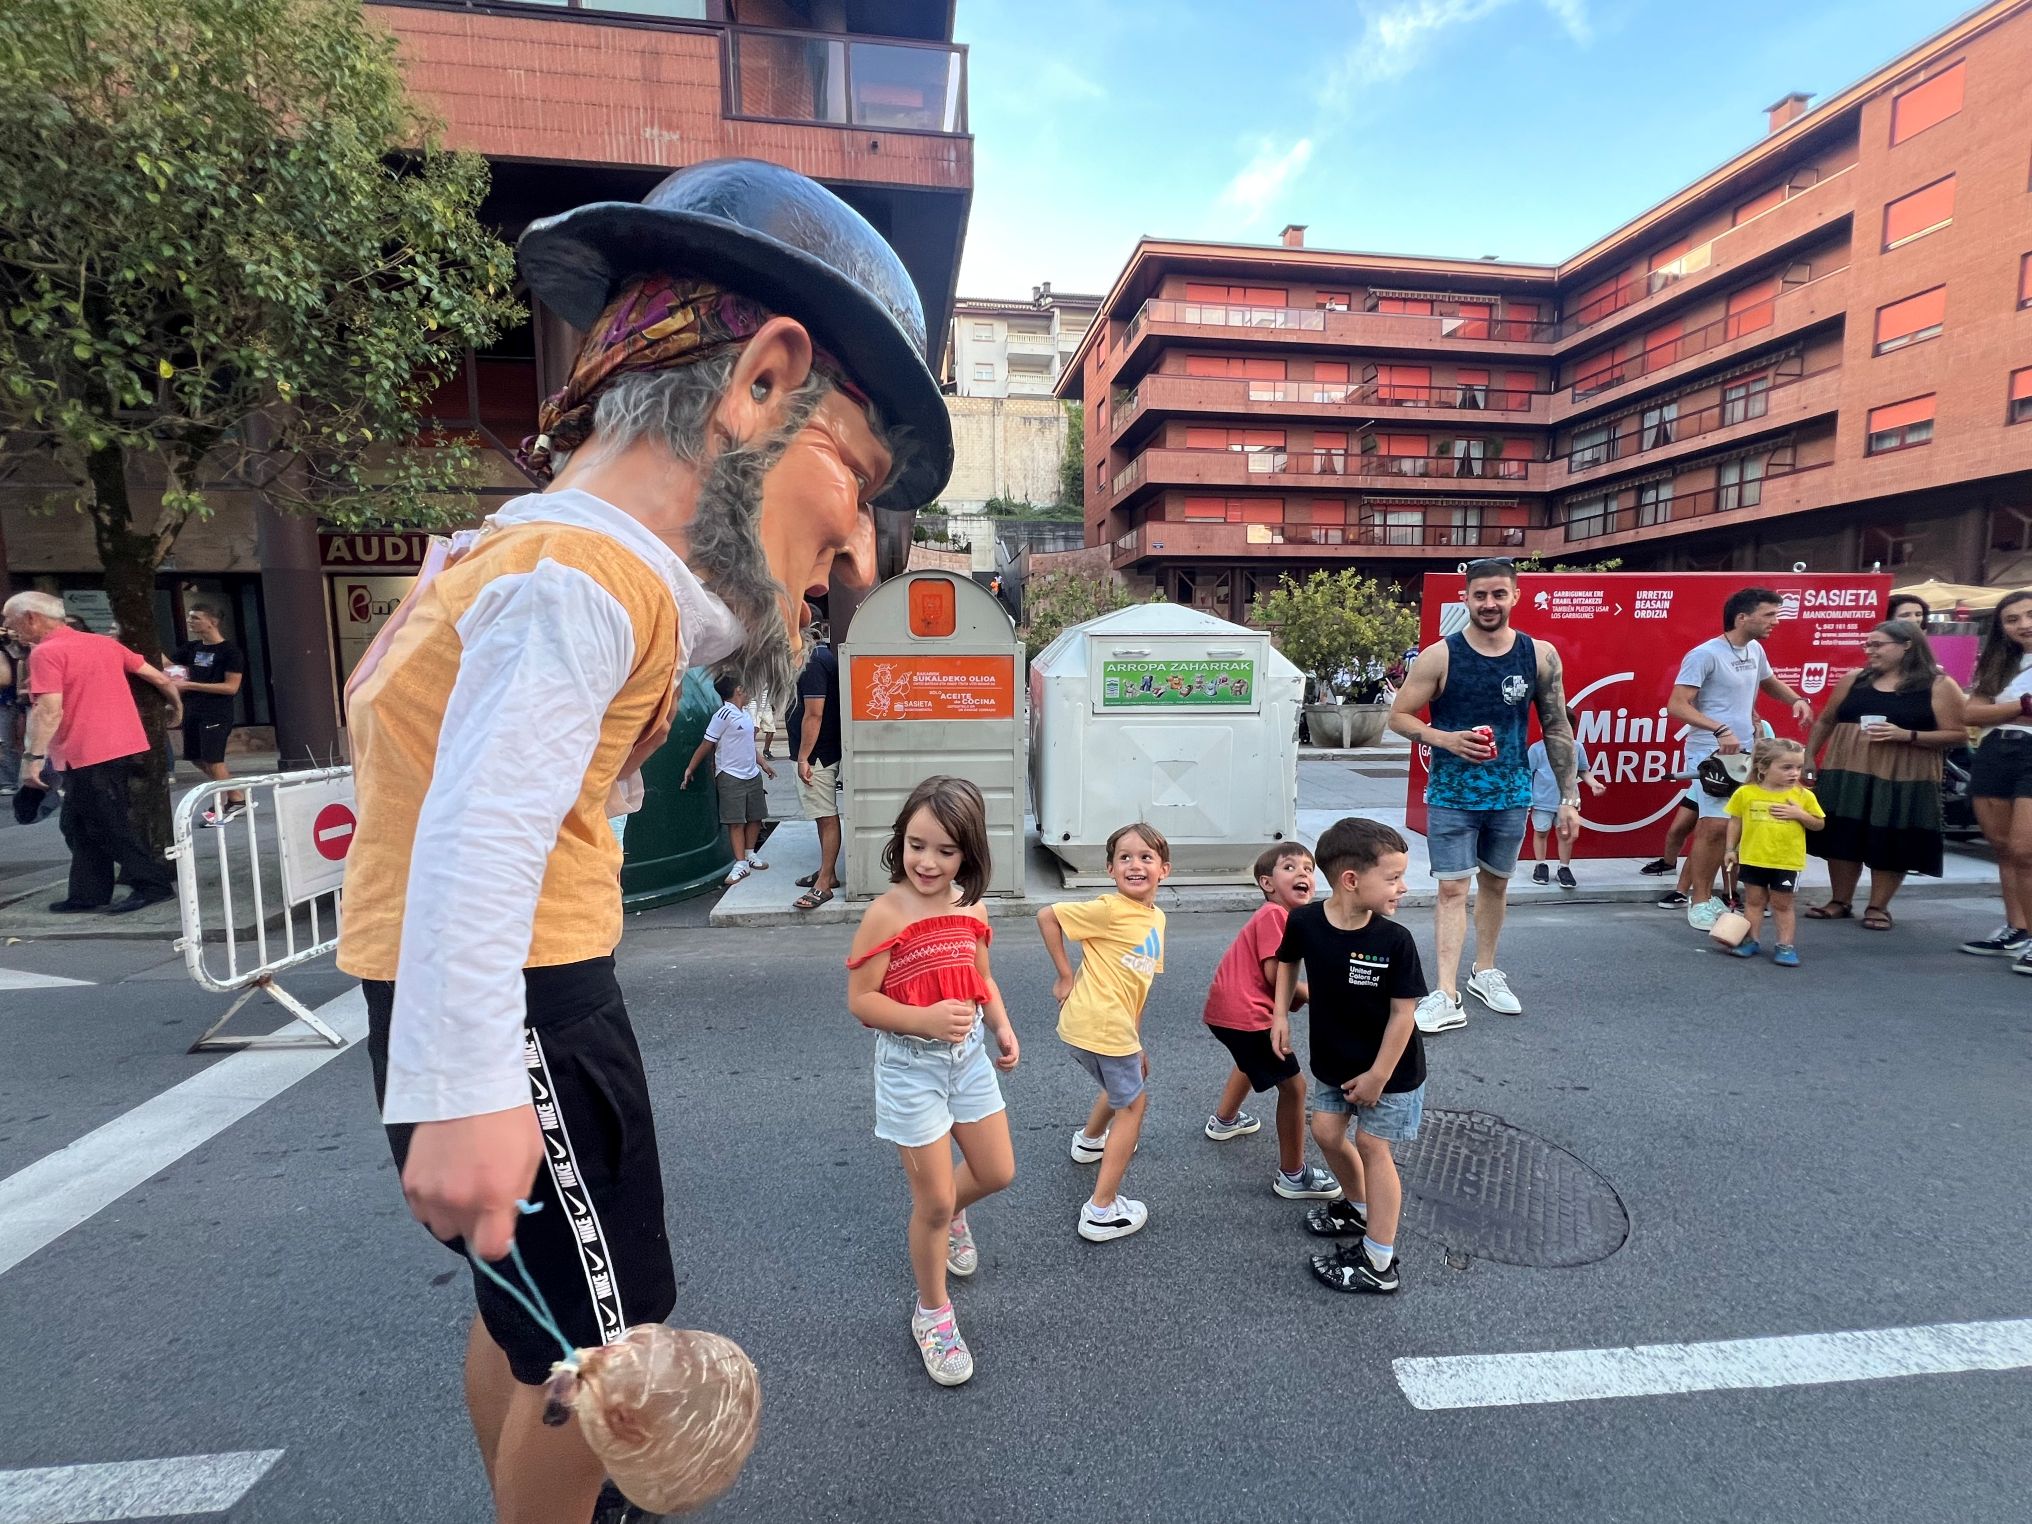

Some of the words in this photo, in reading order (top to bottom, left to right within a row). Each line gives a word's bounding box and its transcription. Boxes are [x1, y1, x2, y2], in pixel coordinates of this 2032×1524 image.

[326, 536, 428, 562] AUDI
[1636, 590, 1674, 600] URRETXU
[1804, 589, 1878, 606] SASIETA
[1635, 600, 1671, 609] BEASAIN
[1634, 609, 1668, 619] ORDIZIA
[1803, 611, 1876, 619] MANKOMUNITATEA
[1106, 664, 1167, 672] ARROPA
[1170, 662, 1250, 671] ZAHARRAK
[904, 700, 933, 708] SASIETA
[1576, 707, 1668, 744] Mini
[1349, 966, 1372, 975] United
[1349, 972, 1371, 980] Colors
[535, 1102, 559, 1130] NIKE
[554, 1161, 578, 1188] NIKE
[575, 1216, 598, 1243] NIKE
[592, 1271, 613, 1299] NIKE
